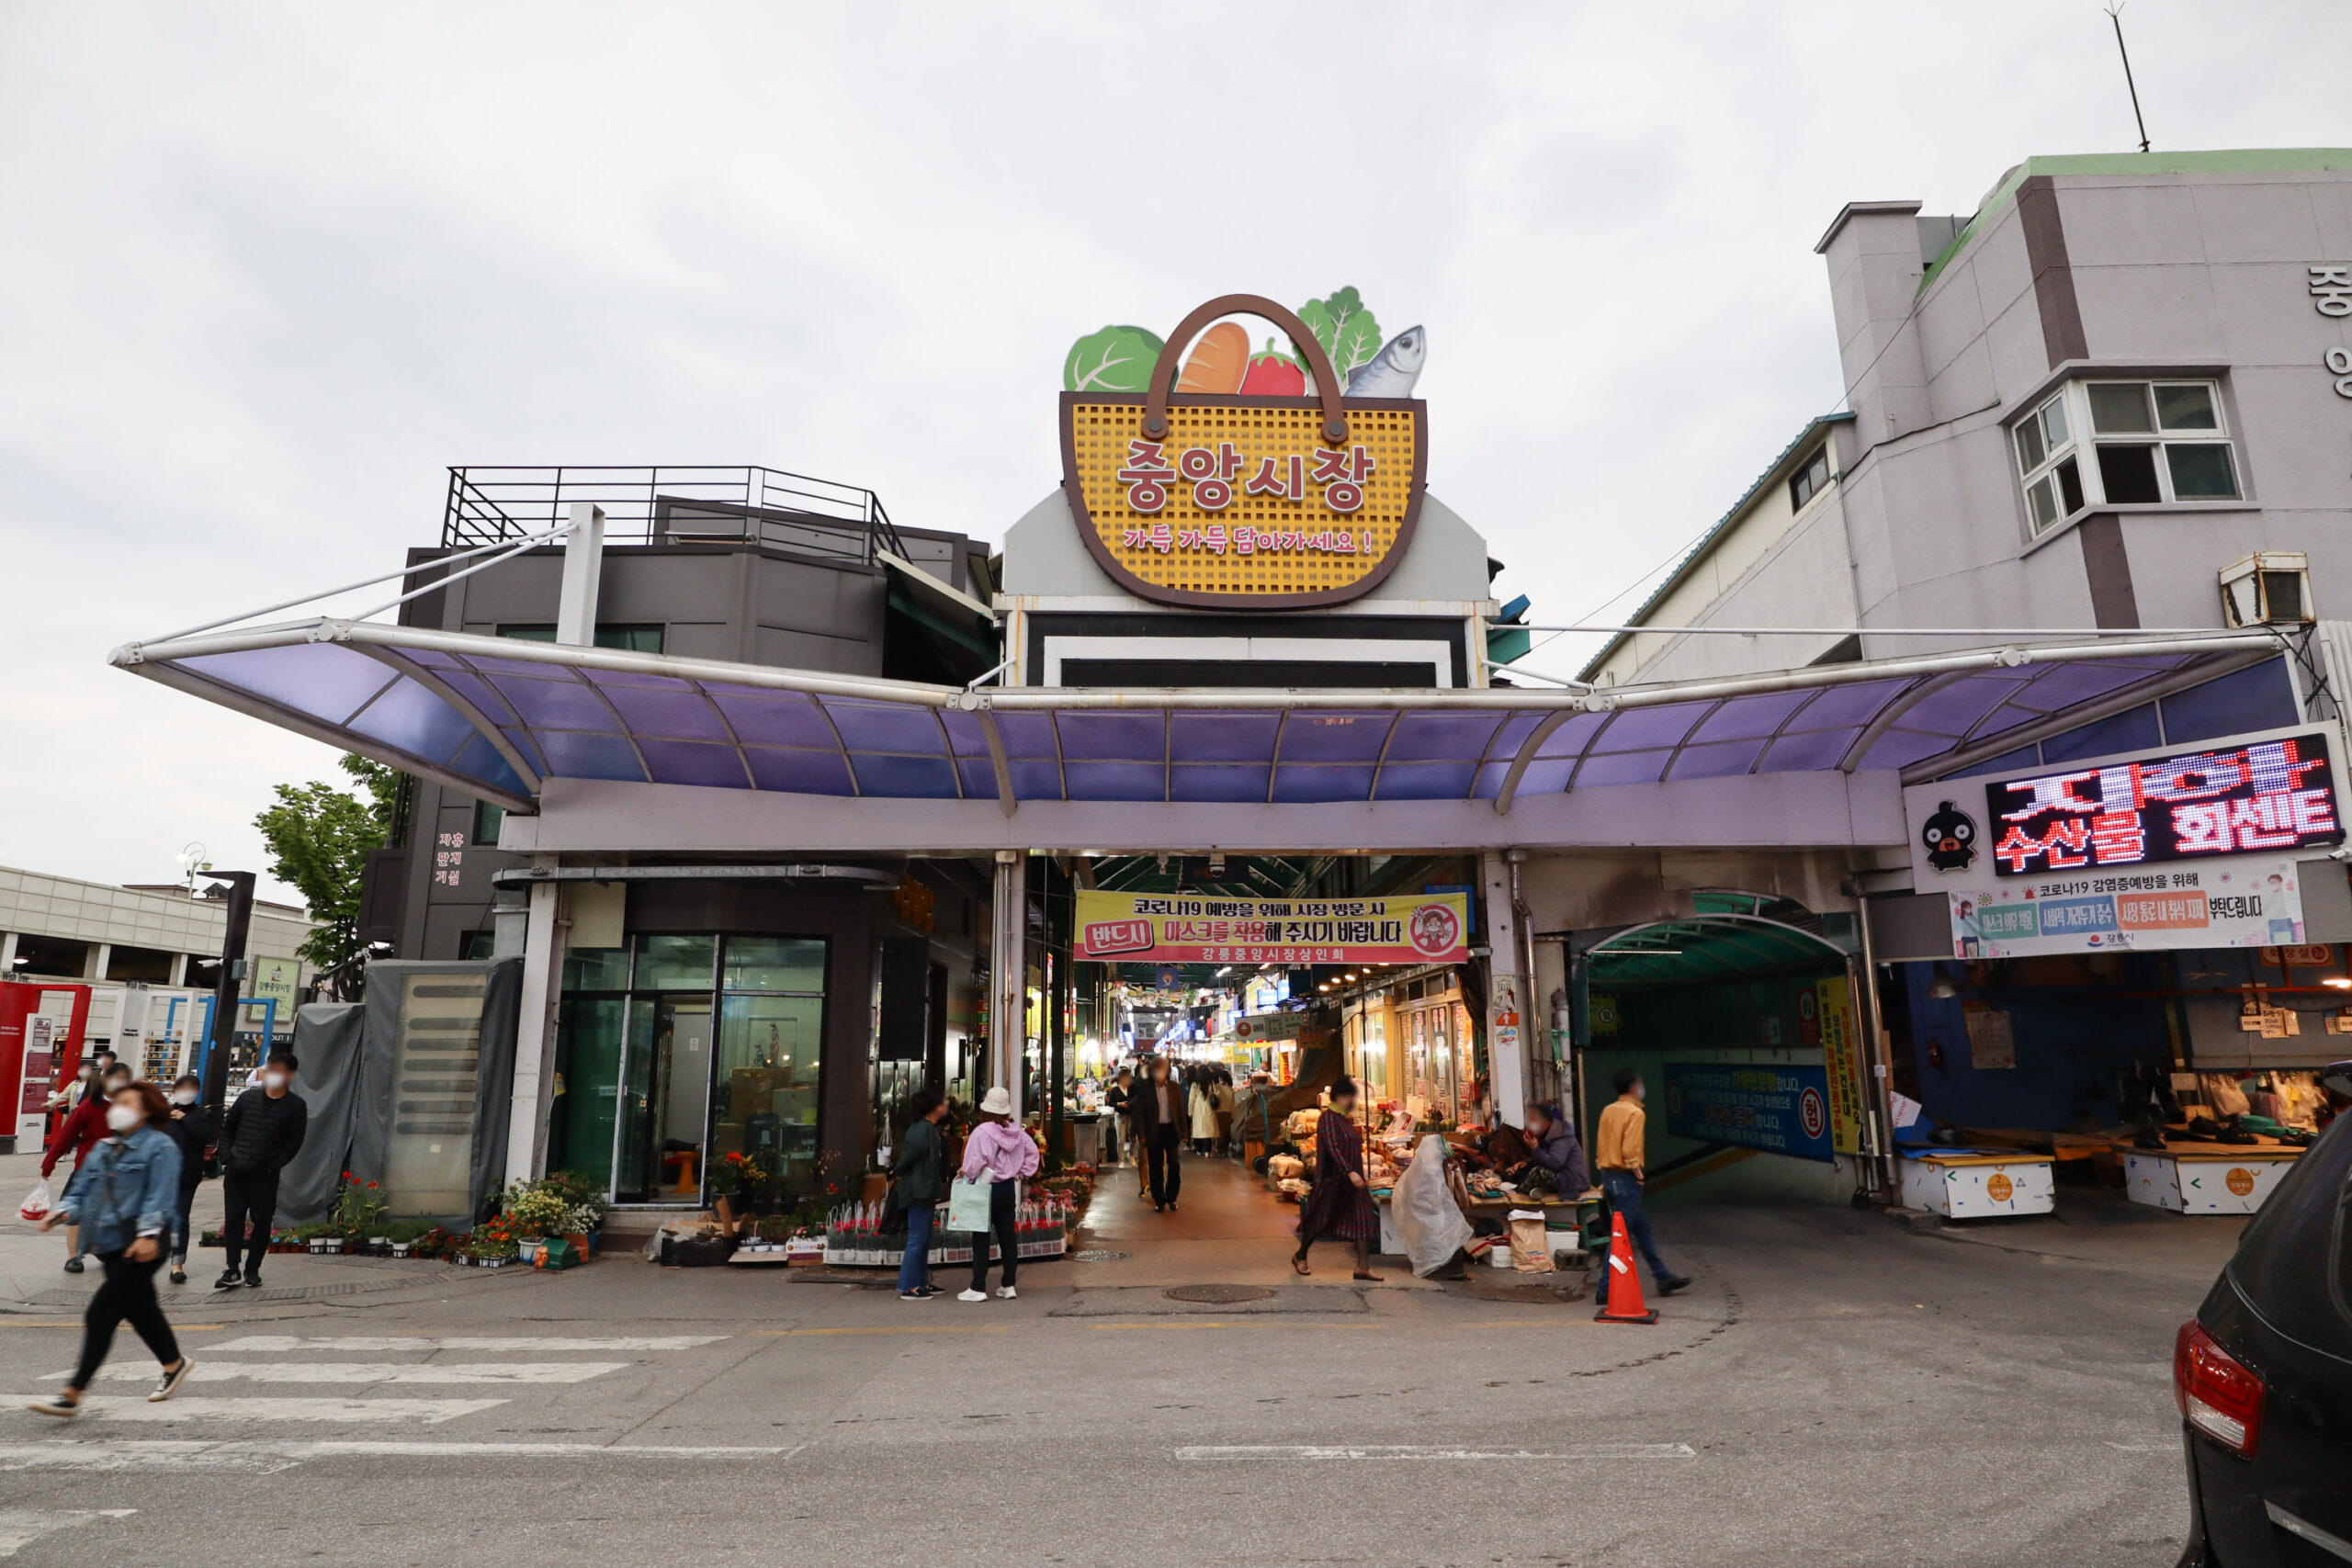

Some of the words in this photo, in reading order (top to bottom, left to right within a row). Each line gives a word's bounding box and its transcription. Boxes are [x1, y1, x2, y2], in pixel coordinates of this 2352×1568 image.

[1117, 439, 1375, 514] 중앙시장
[1124, 524, 1173, 553] 가득
[1179, 525, 1228, 554] 가득
[1995, 808, 2146, 873] 수산물
[2040, 882, 2089, 897] 코로나19
[2092, 874, 2167, 893] 감염증예방을
[2172, 873, 2199, 887] 위해
[1133, 899, 1202, 917] 코로나19
[1204, 901, 1254, 918] 예방을
[1257, 901, 1292, 918] 위해
[1294, 901, 1329, 918] 시장
[1331, 901, 1364, 918] 방문
[1368, 901, 1386, 917] 시
[2043, 908, 2065, 928] 사회적
[2065, 905, 2096, 926] 거리두기
[2097, 903, 2113, 925] 준수
[2122, 902, 2138, 923] 시장
[2140, 900, 2156, 922] 통로
[2209, 895, 2263, 919] 부탁드립니다
[1091, 923, 1146, 949] 반드시
[1164, 921, 1229, 944] 마스크를
[1233, 920, 1283, 943] 착용해
[1285, 921, 1334, 943] 주시기
[1337, 920, 1402, 943] 바랍니다
[2107, 932, 2134, 943] 강릉시
[1202, 948, 1344, 962] 강릉중앙시장상인회
